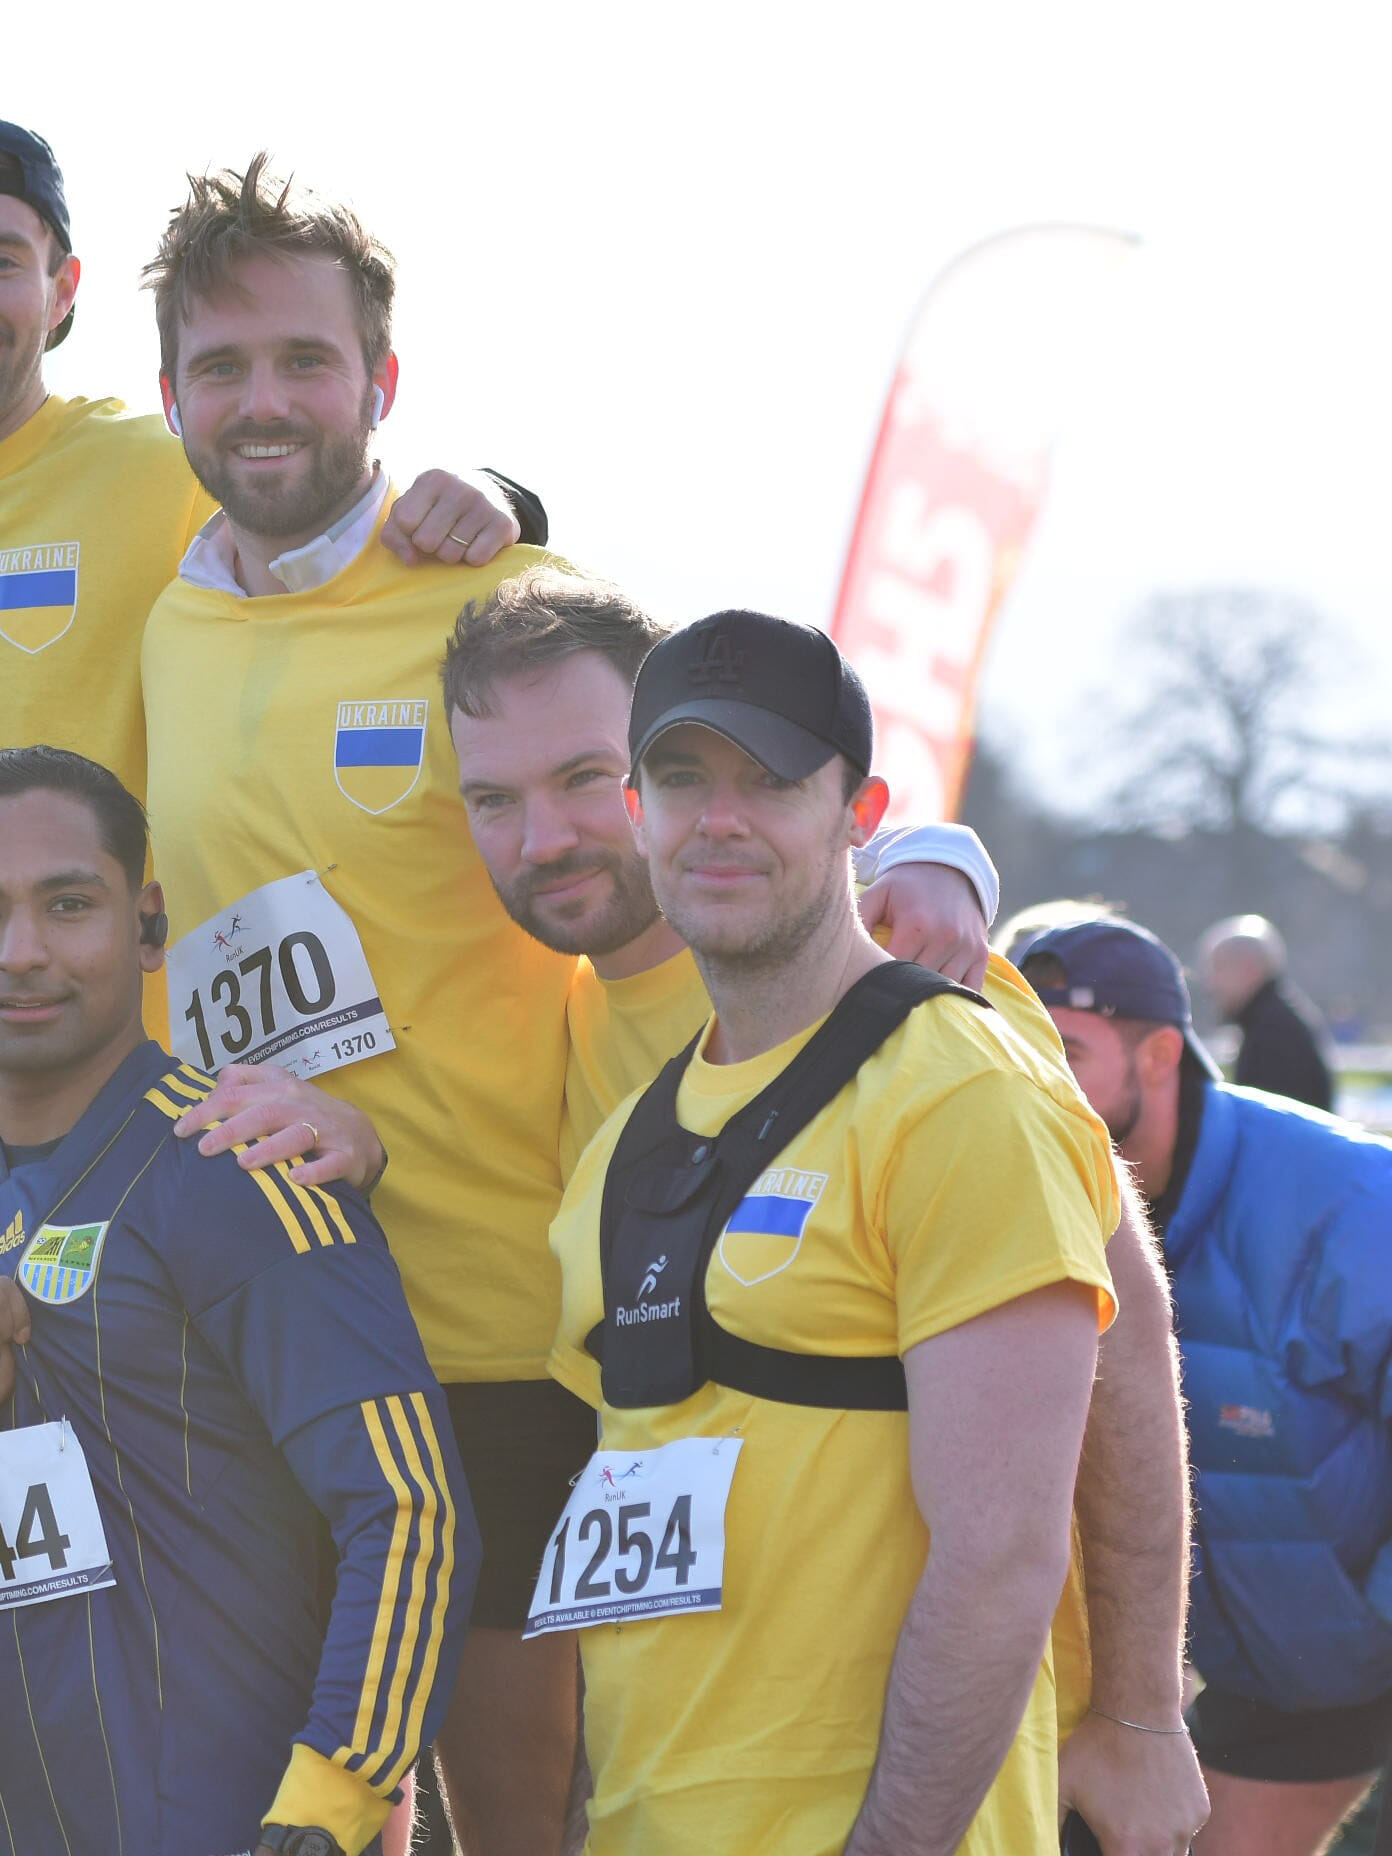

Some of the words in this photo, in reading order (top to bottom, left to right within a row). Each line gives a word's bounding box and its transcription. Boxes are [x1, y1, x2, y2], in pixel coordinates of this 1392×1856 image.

[0, 546, 76, 572] UKRAINE
[340, 704, 424, 727] UKRAINE
[185, 931, 336, 1070] 1370
[331, 1031, 376, 1060] 1370
[752, 1173, 823, 1198] KRAINE
[616, 1296, 681, 1327] RunSmart
[604, 1490, 626, 1503] RunUK
[549, 1494, 697, 1605] 1254
